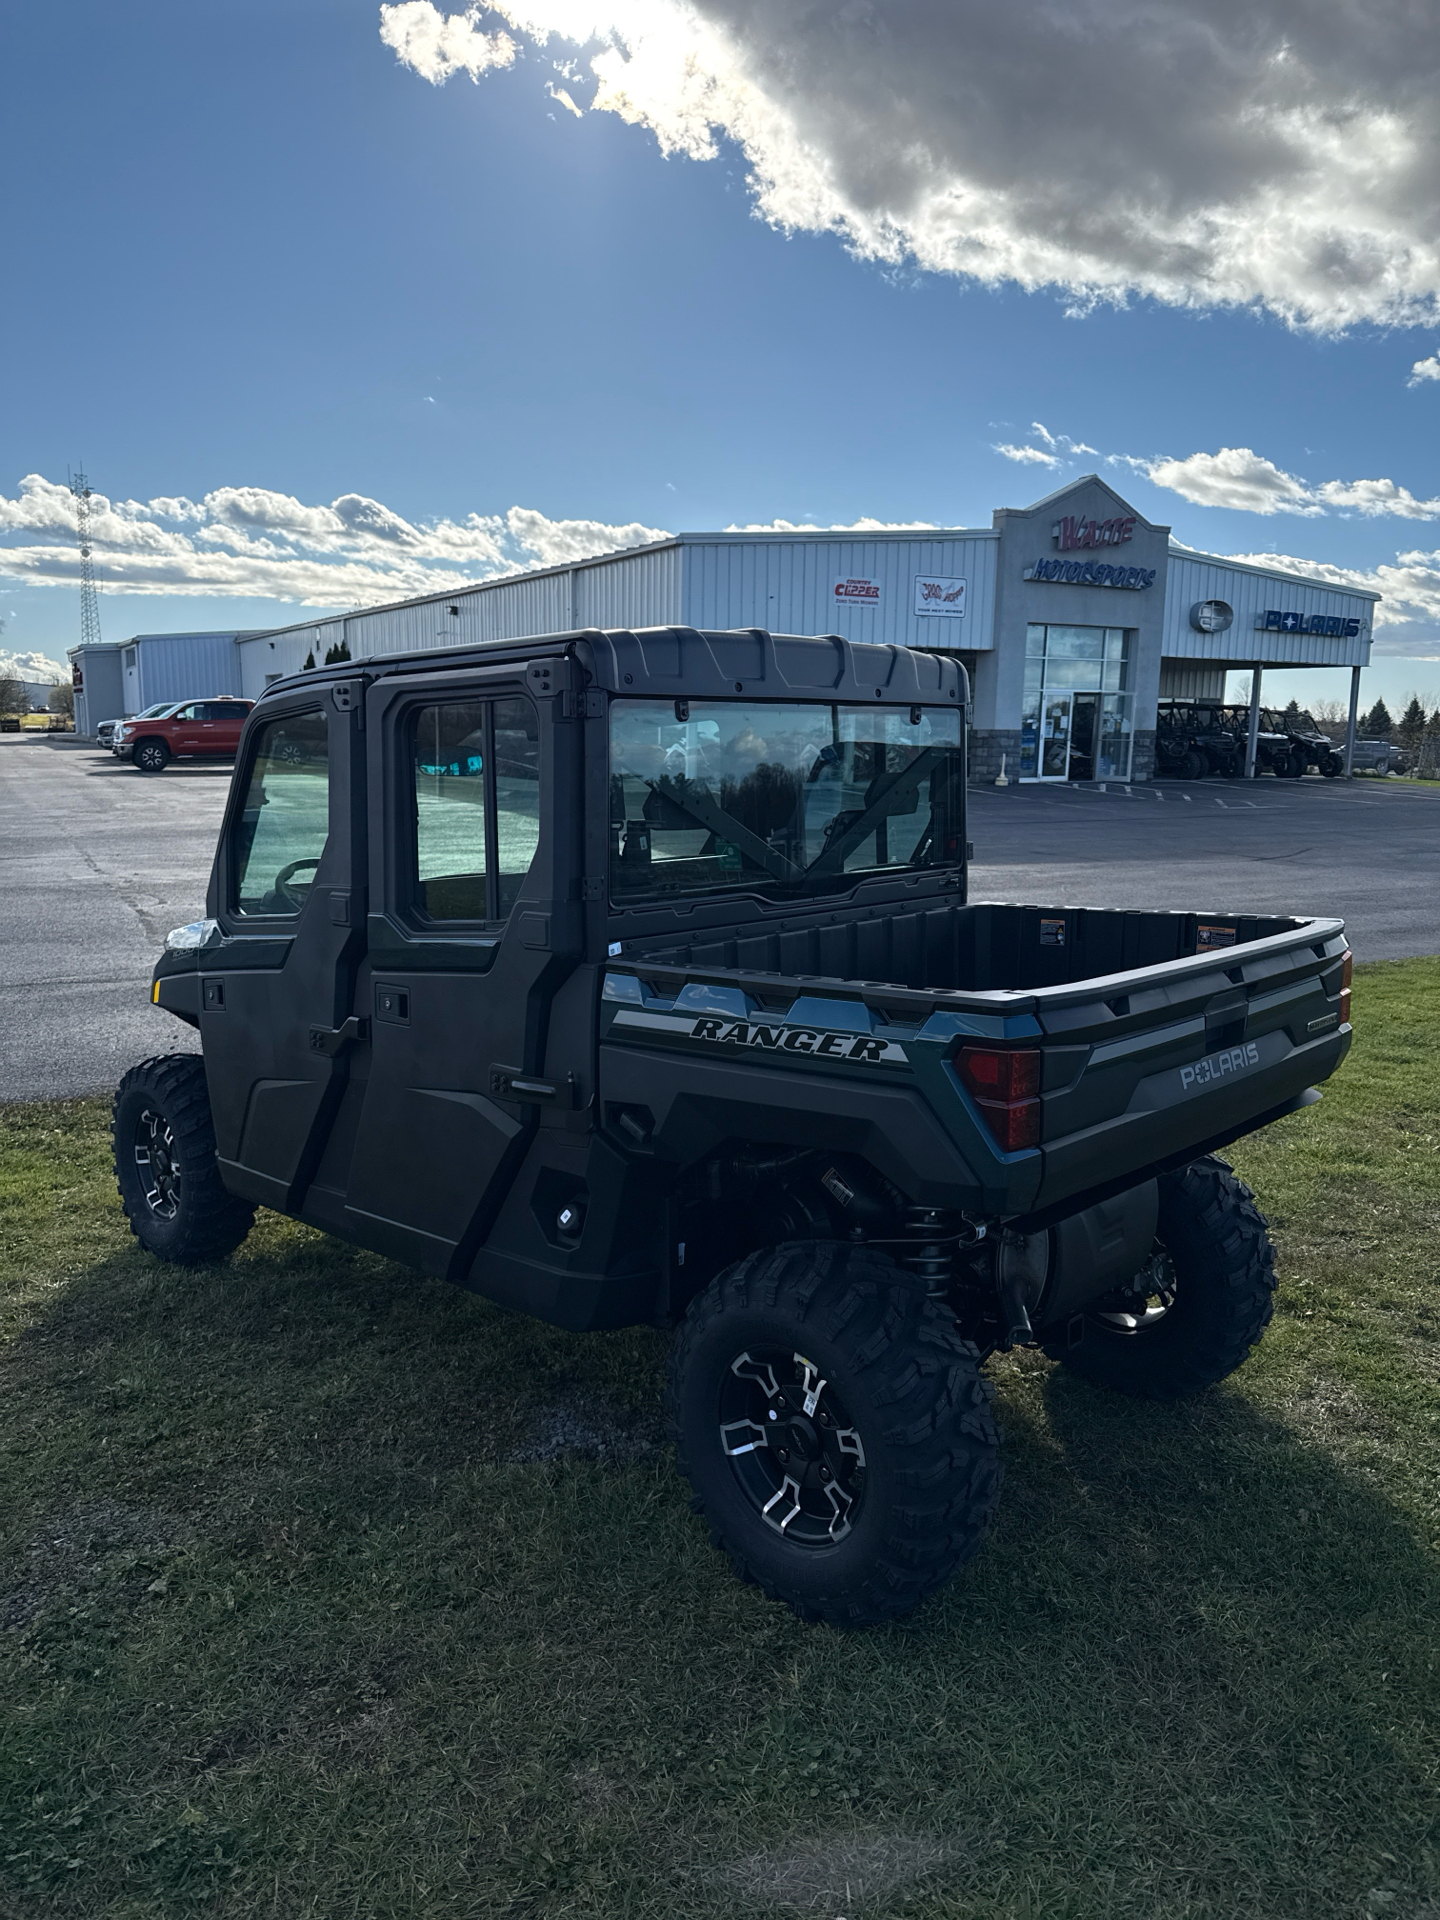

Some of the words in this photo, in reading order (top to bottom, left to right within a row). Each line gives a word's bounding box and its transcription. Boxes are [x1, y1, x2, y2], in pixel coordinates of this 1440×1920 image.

[1058, 515, 1136, 550] WAITE
[1033, 558, 1156, 589] MOTORSPORTS
[835, 583, 880, 598] CLIPPER
[1264, 610, 1361, 637] POLARIS
[689, 1017, 889, 1063] RANGER
[1180, 1043, 1259, 1090] POLARIS
